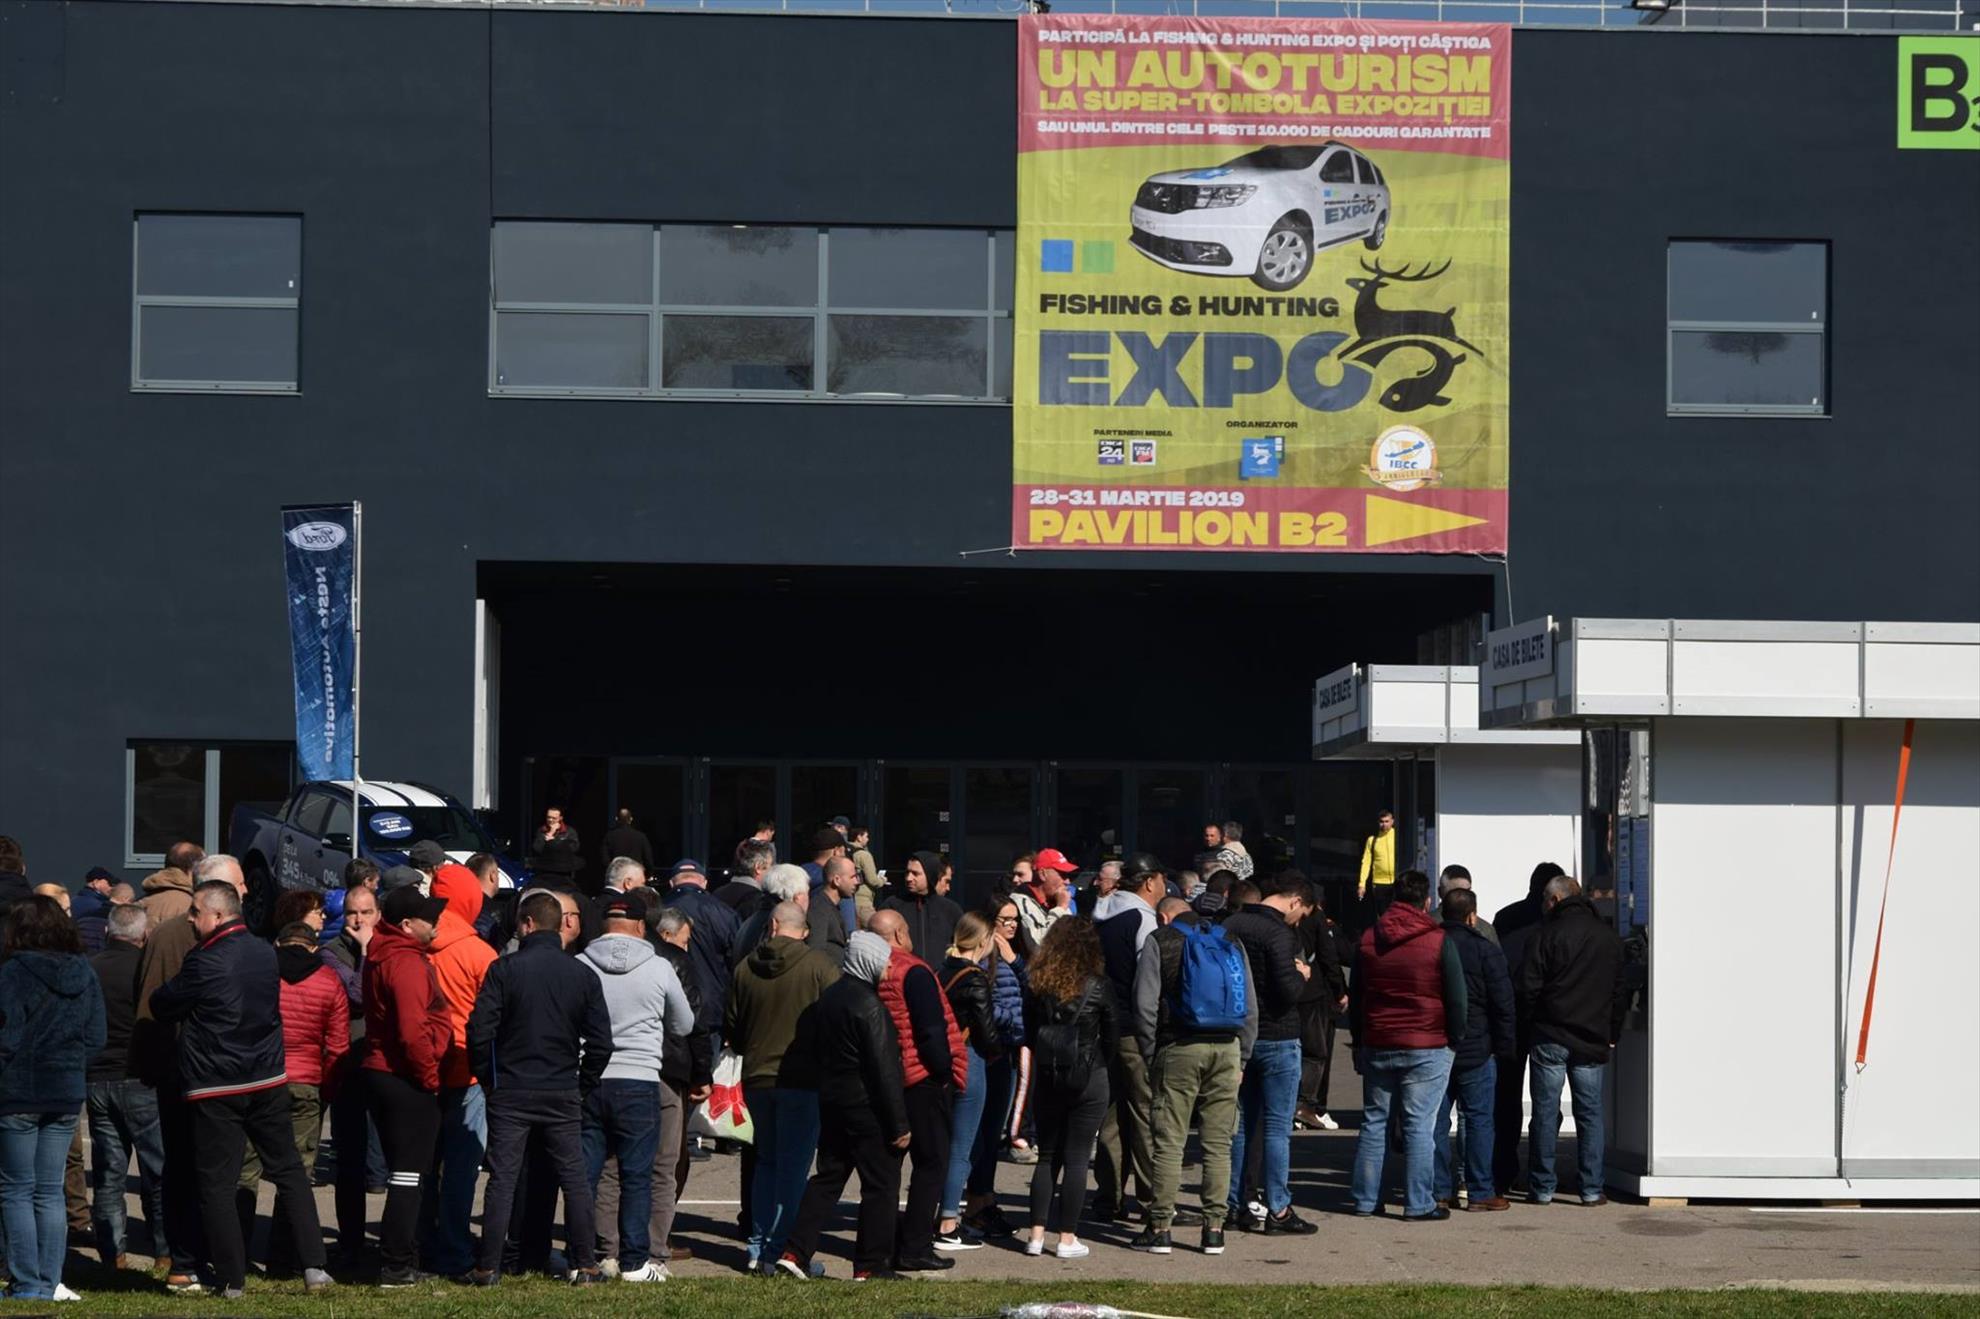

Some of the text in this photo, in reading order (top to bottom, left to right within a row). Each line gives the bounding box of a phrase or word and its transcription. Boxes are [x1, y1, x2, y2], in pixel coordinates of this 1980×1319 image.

[1038, 29, 1126, 43] PARTICIPĂ
[1128, 31, 1151, 43] LA
[1153, 31, 1217, 45] FISHING
[1220, 33, 1233, 45] &
[1236, 33, 1309, 46] HUNTING
[1312, 34, 1357, 47] EXPO
[1038, 48, 1491, 94] UN AUTOTURISM
[1039, 90, 1078, 111] LA
[1083, 90, 1332, 114] SUPER-TOMBOLA
[1038, 120, 1491, 138] SAU UNUL DINTRE CELE PESTE 10.000 DE CADOURI GARANTATE
[1324, 204, 1369, 225] EXPO
[1039, 293, 1340, 318] FISHING & HUNTING
[1039, 329, 1374, 413] EXPO
[1093, 429, 1144, 437] PARTENERI
[1226, 420, 1298, 429] ORGANIZATOR
[1100, 446, 1123, 460] 24
[1030, 490, 1245, 507] 28-31 MARTIE 2019
[1029, 509, 1347, 546] PAVILION B2
[1493, 634, 1544, 669] CASA DE BILETE
[1226, 955, 1245, 1013] adidas
